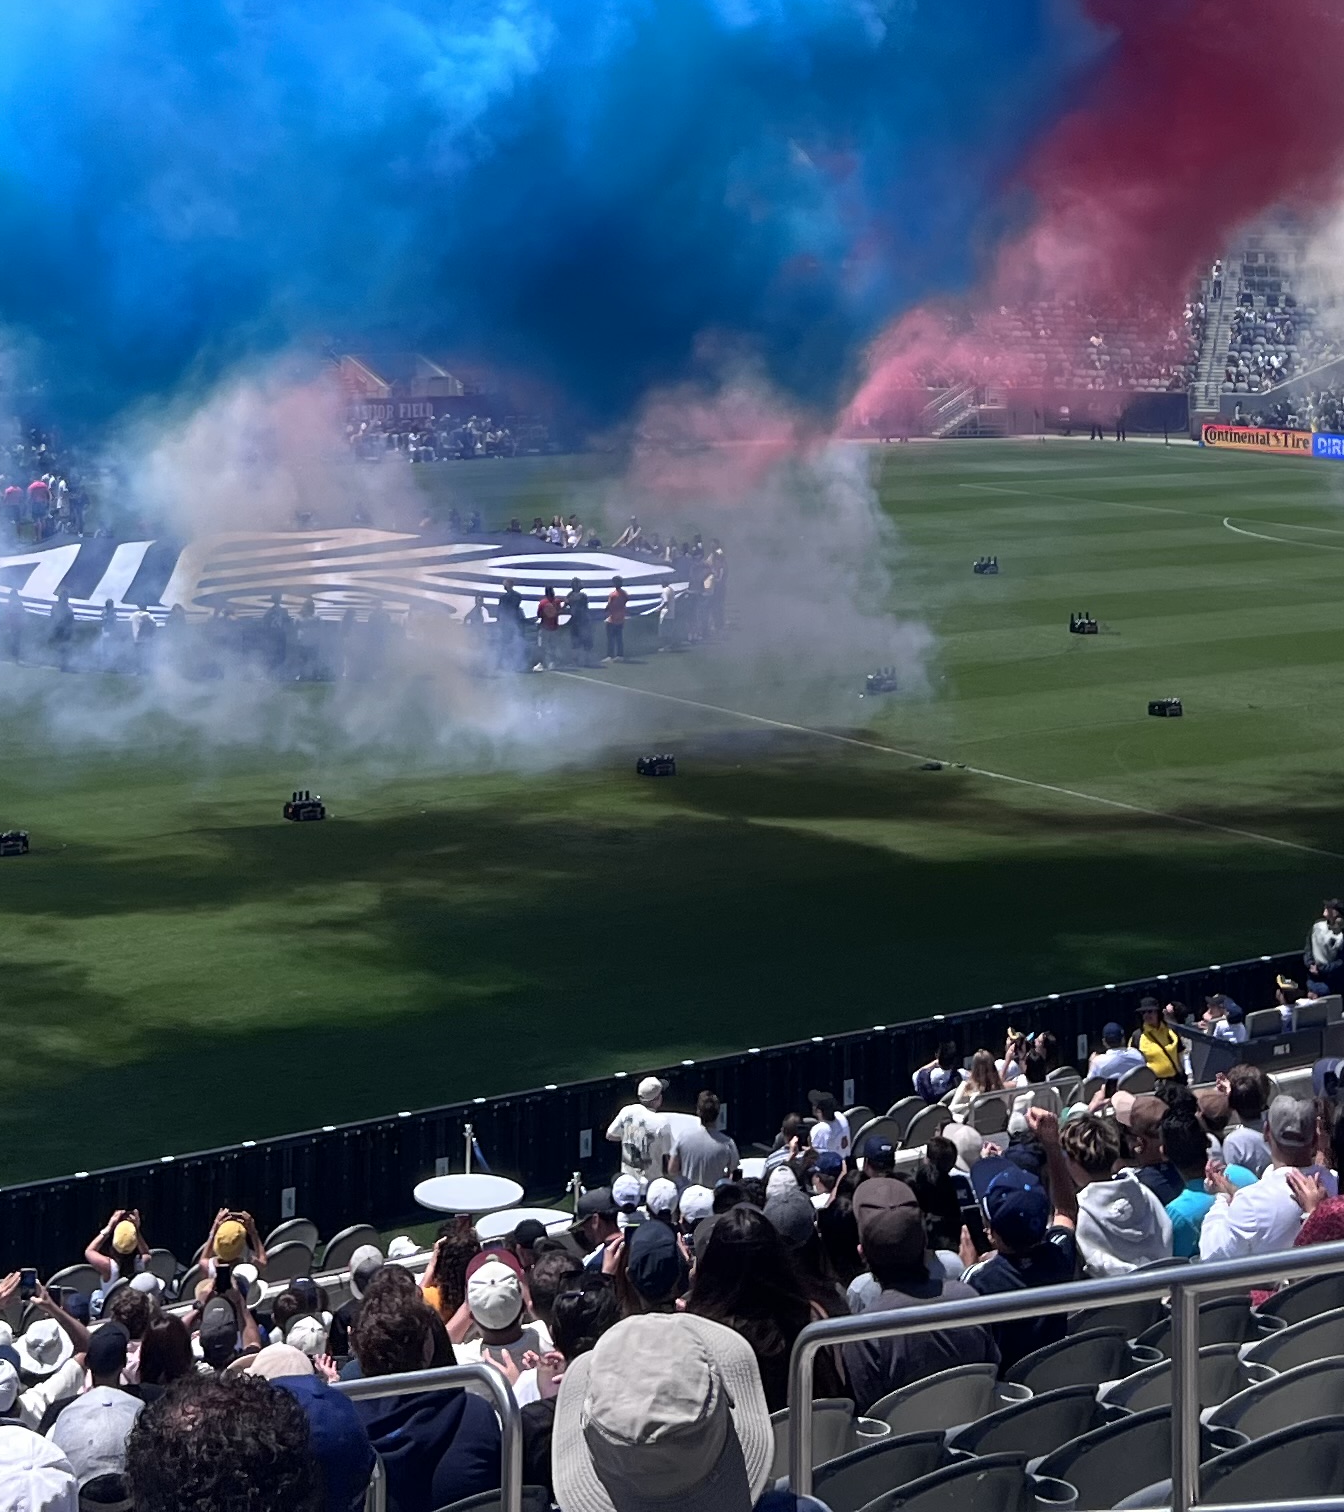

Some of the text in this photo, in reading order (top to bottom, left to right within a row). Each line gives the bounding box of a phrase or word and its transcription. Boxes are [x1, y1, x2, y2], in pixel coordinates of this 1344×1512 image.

[399, 402, 434, 418] FIELD
[1205, 425, 1311, 450] Continental Tire
